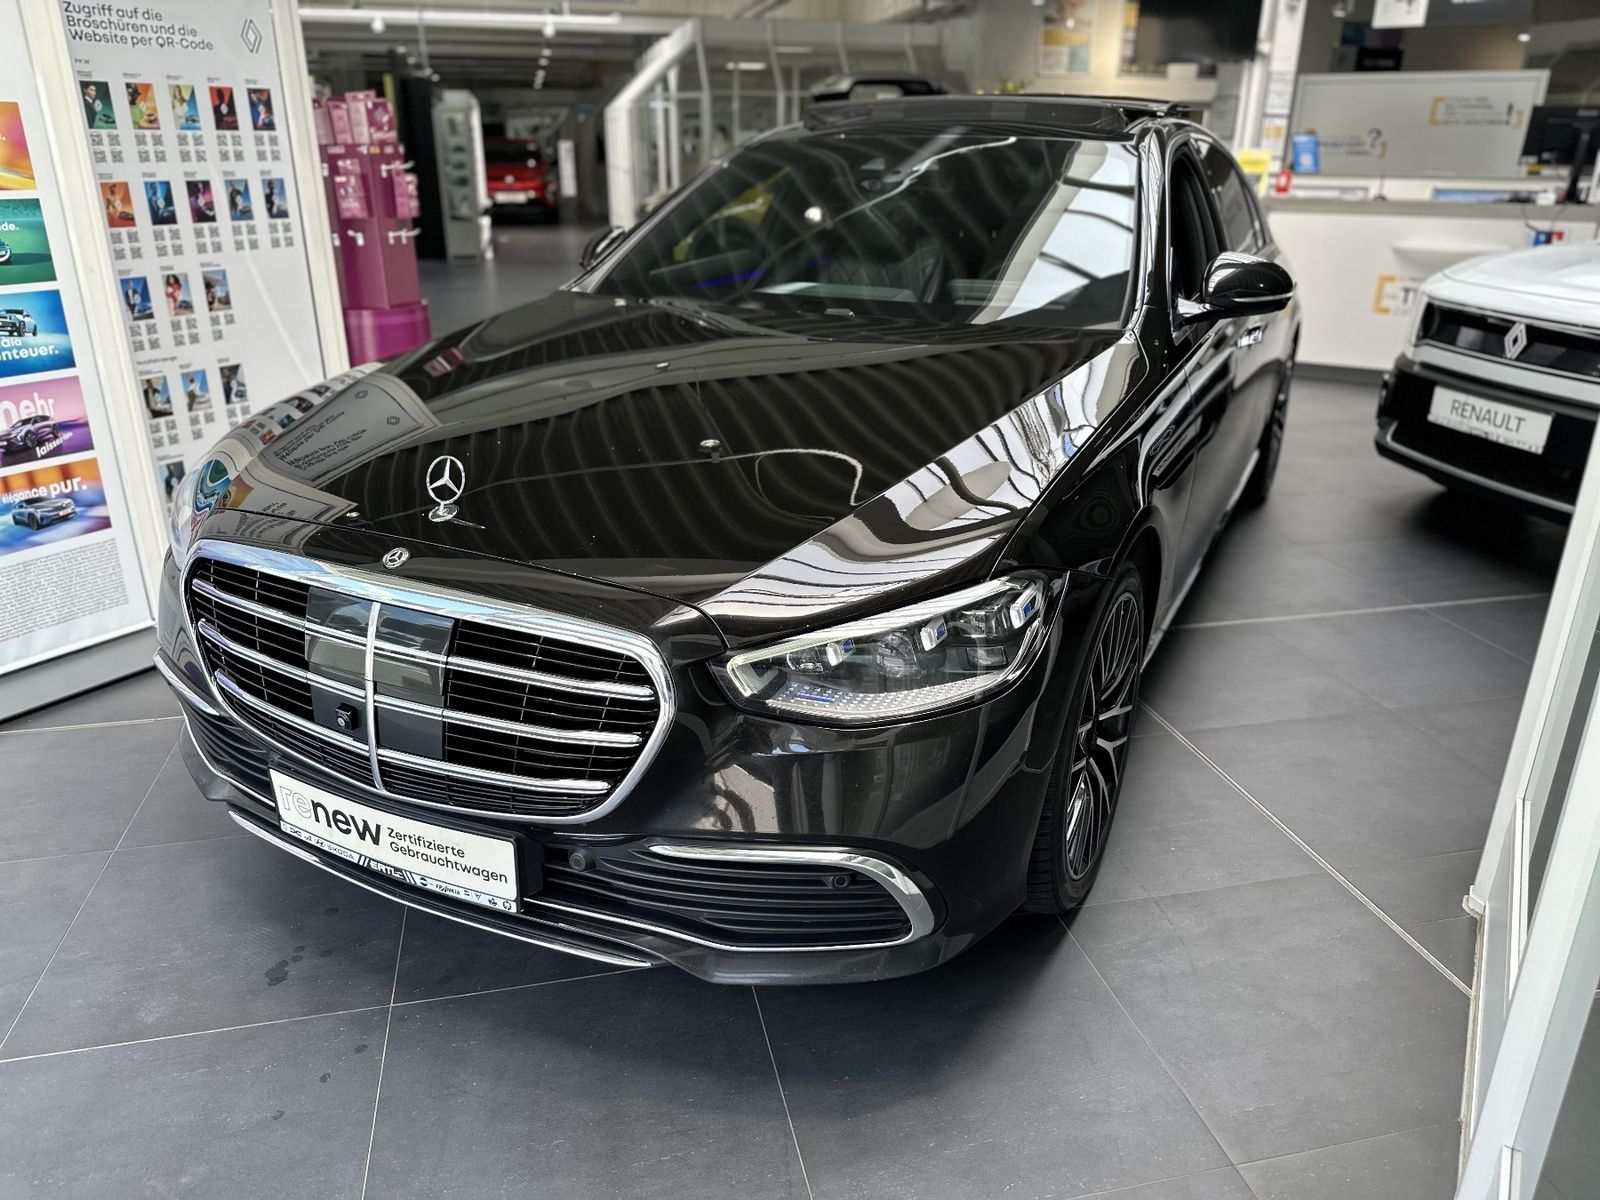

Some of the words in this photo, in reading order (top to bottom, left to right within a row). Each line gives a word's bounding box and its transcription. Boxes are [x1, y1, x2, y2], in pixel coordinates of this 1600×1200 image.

[63, 1, 113, 17] Zugriff
[115, 8, 139, 19] auf
[142, 8, 163, 21] die
[66, 15, 148, 33] Broschüren
[151, 24, 176, 35] und
[178, 24, 198, 37] die
[68, 29, 129, 45] Website
[131, 35, 152, 48] per
[155, 36, 214, 51] QR-Code
[0, 344, 60, 361] nteuer.
[1449, 398, 1527, 434] RENAULT
[49, 477, 88, 498] pur.
[279, 786, 381, 846] renew
[387, 827, 465, 858] Zertifizierte
[389, 841, 509, 884] Gebrauchtwagen
